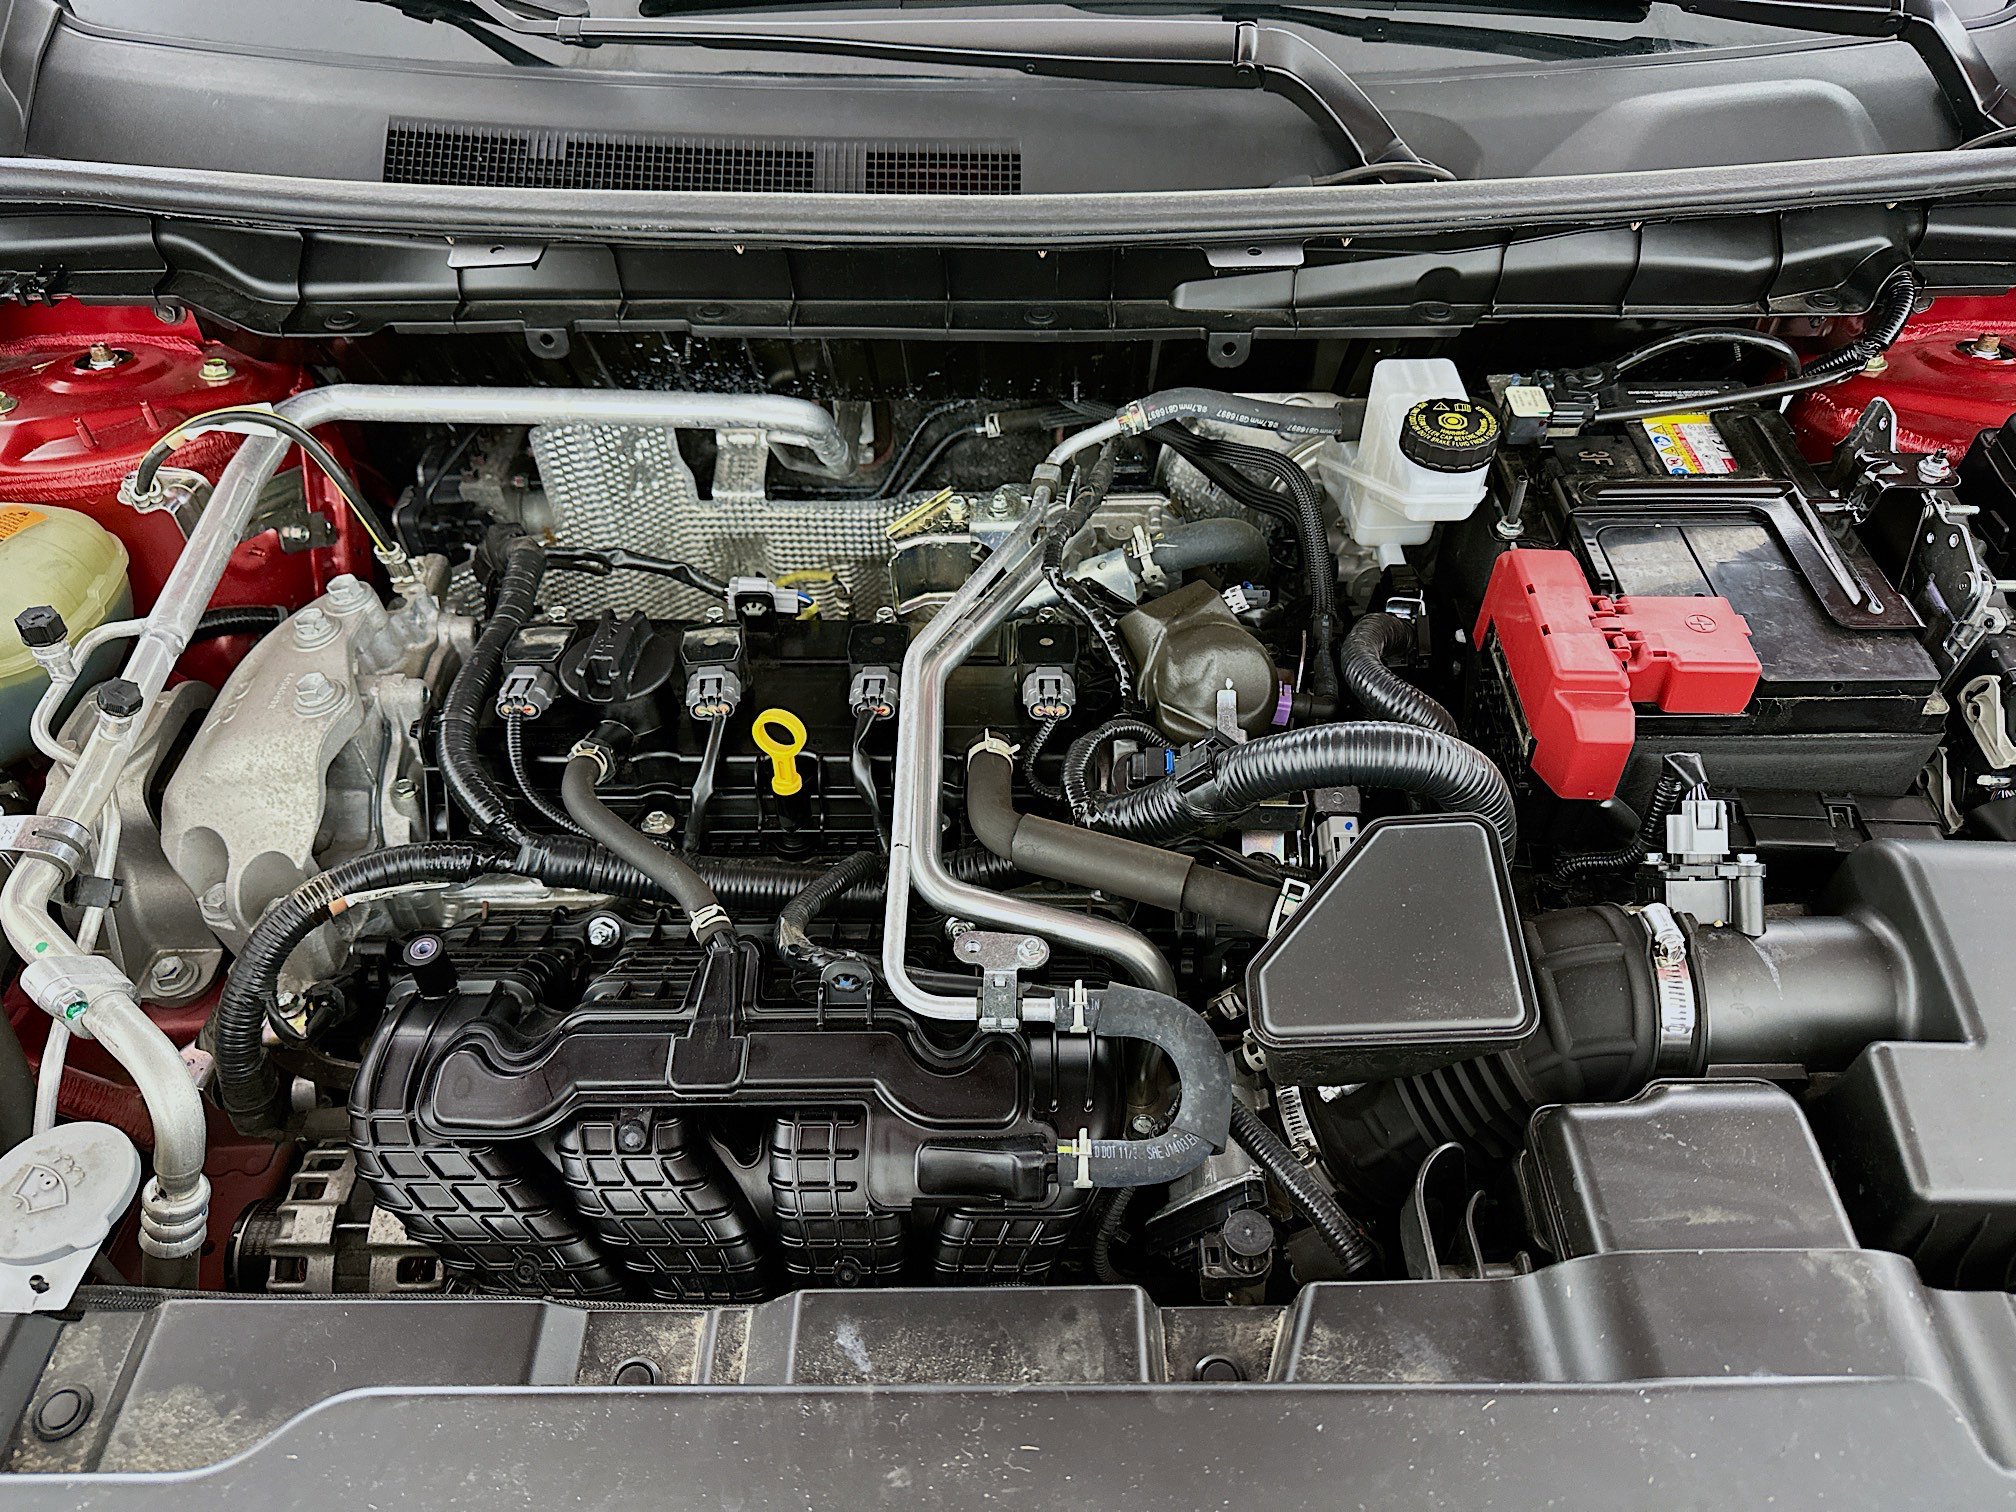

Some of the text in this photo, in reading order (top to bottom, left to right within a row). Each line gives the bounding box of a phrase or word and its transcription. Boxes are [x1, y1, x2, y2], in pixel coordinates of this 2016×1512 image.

[1147, 404, 1178, 421] GB16897
[1216, 408, 1250, 423] GB16897
[1101, 1146, 1116, 1159] DOT
[1146, 1146, 1164, 1160] SAE
[1164, 1137, 1190, 1157] J1403
